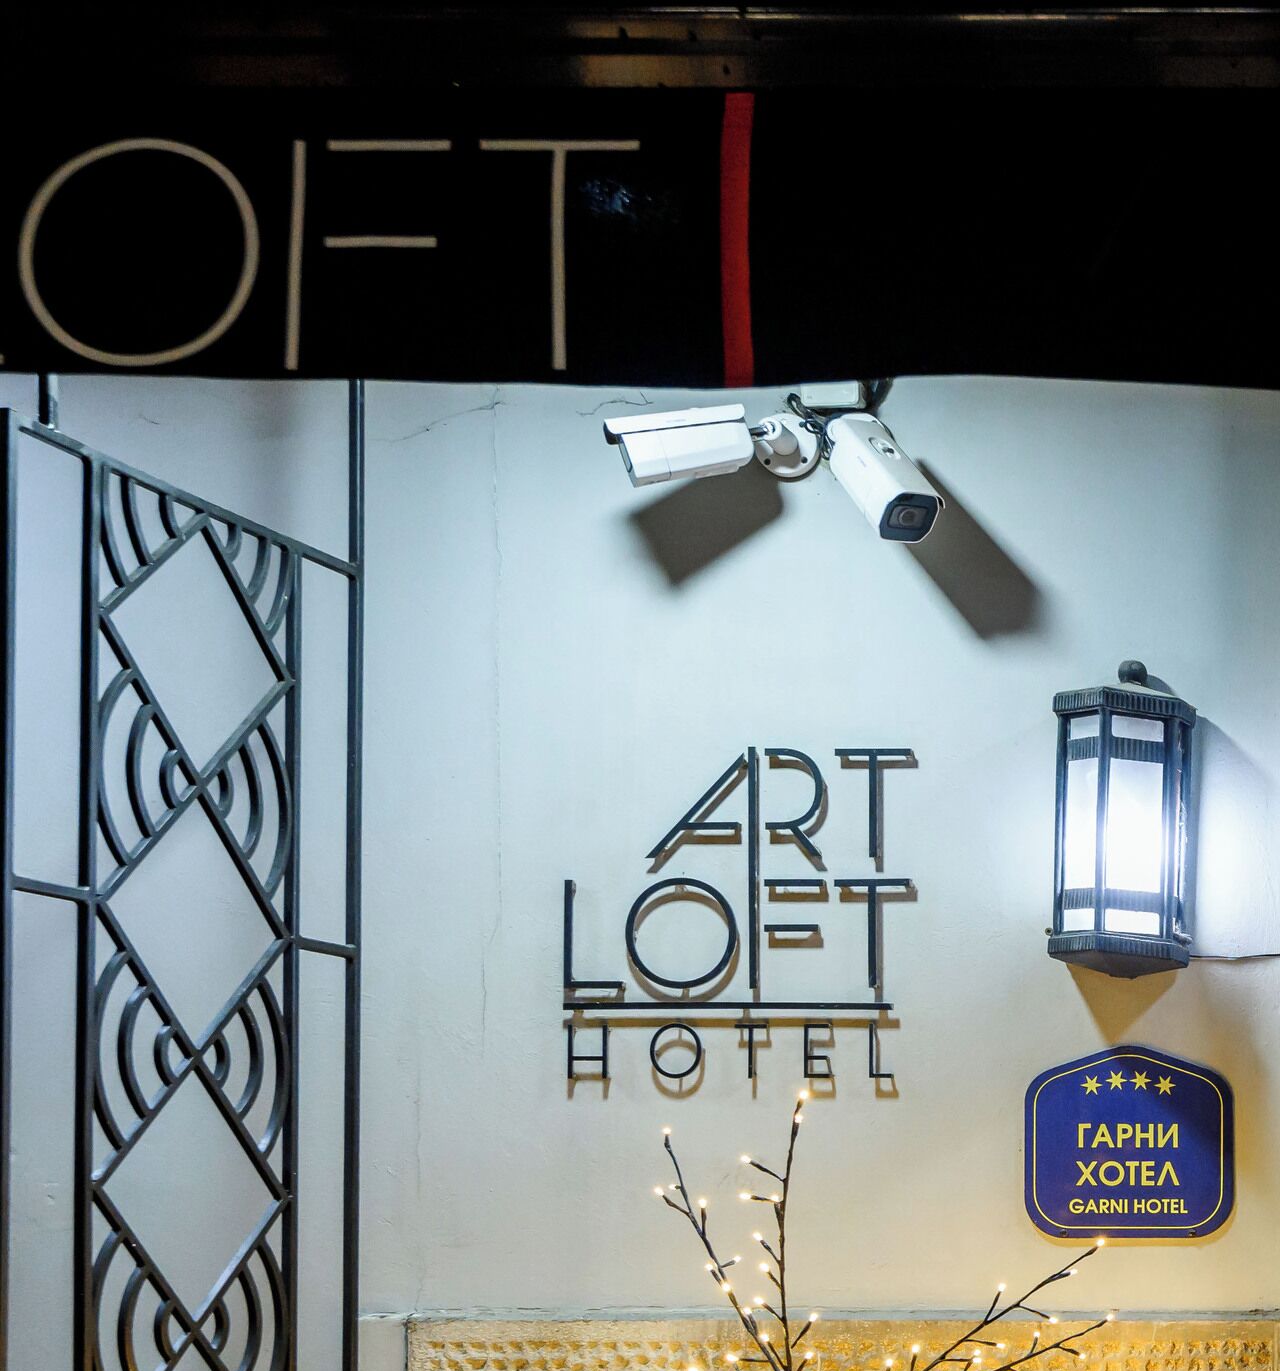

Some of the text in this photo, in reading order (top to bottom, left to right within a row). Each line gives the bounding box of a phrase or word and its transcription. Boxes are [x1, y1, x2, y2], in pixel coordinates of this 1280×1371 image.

[0, 138, 641, 371] OFT
[645, 747, 914, 859] ART
[564, 877, 914, 990] LOFT
[567, 1023, 895, 1080] HOTEL
[1077, 1123, 1179, 1148] ГАРНИ
[1075, 1161, 1180, 1186] ХОТЕЛ
[1069, 1199, 1188, 1214] GARNI HOTEL
